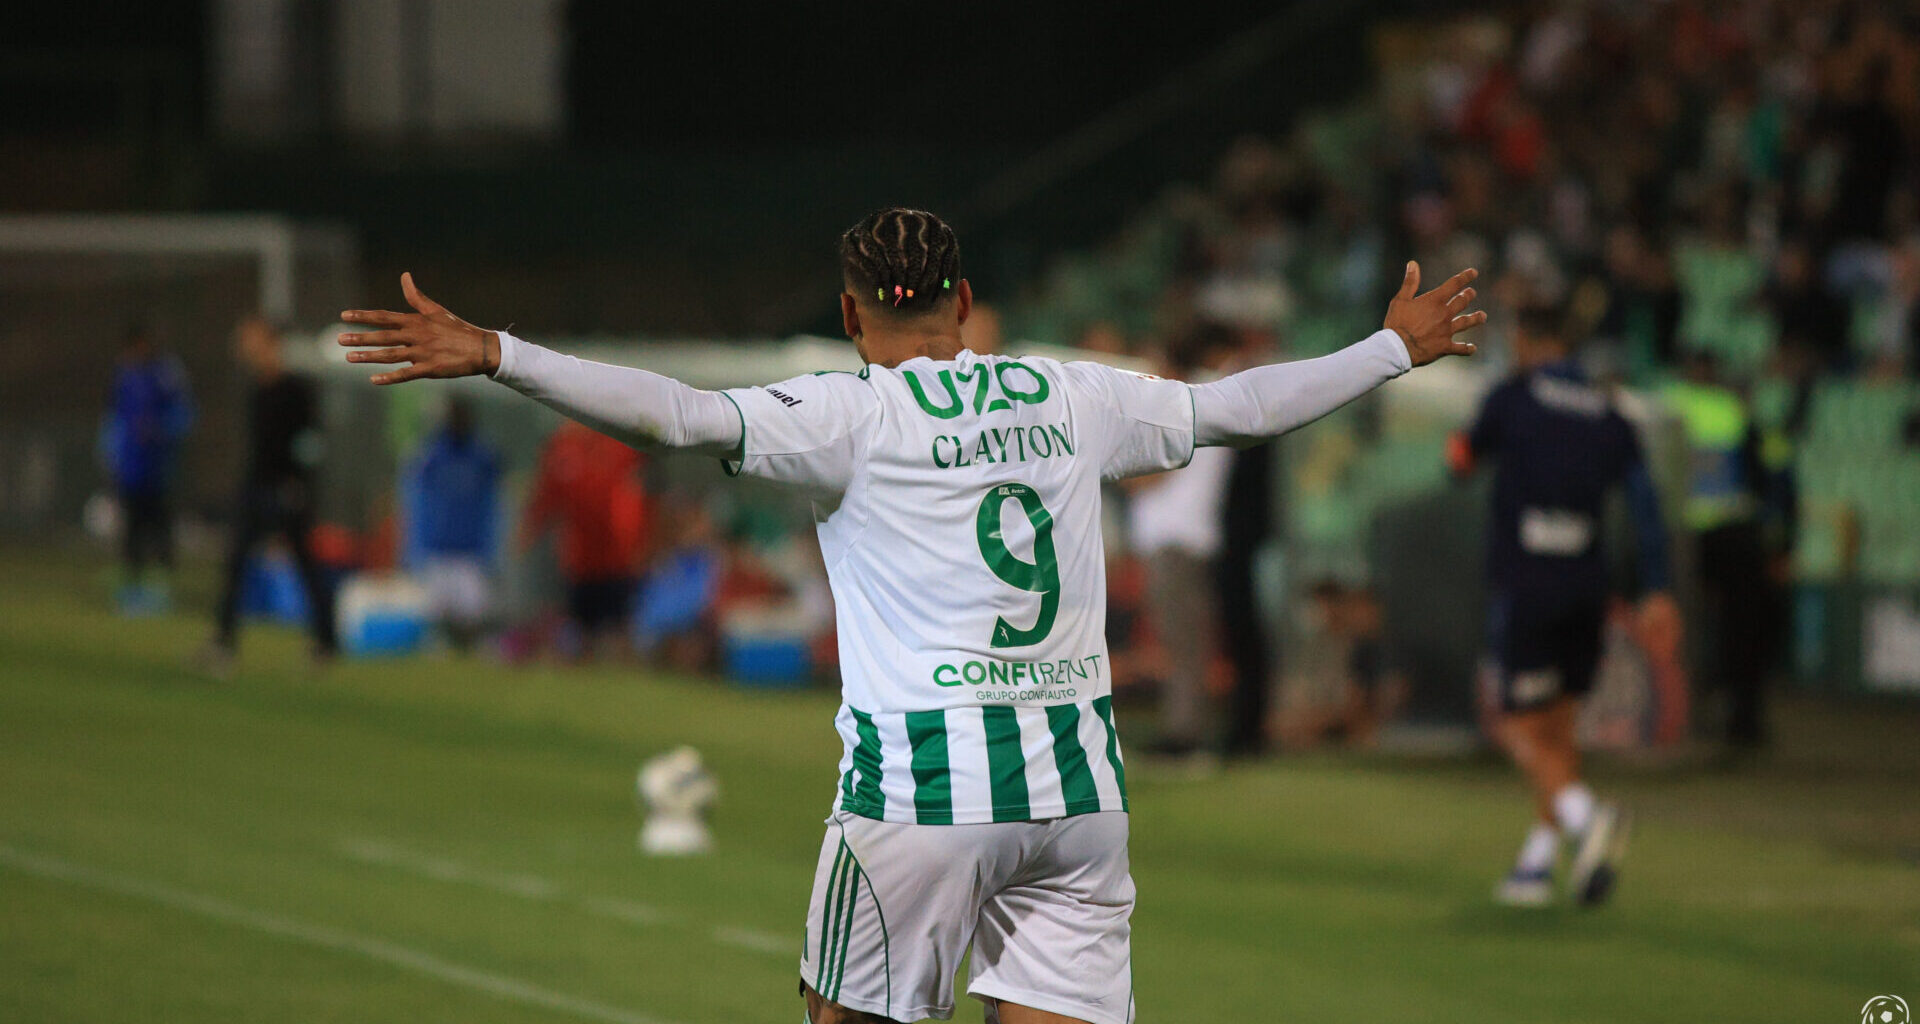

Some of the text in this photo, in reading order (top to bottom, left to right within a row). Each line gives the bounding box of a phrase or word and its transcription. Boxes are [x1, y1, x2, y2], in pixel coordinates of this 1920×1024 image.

[932, 422, 1075, 469] CLAYTON
[976, 482, 1061, 648] 9
[933, 655, 1101, 687] CONFIRENT
[976, 688, 1077, 701] GRUPO CONFIAUTO
